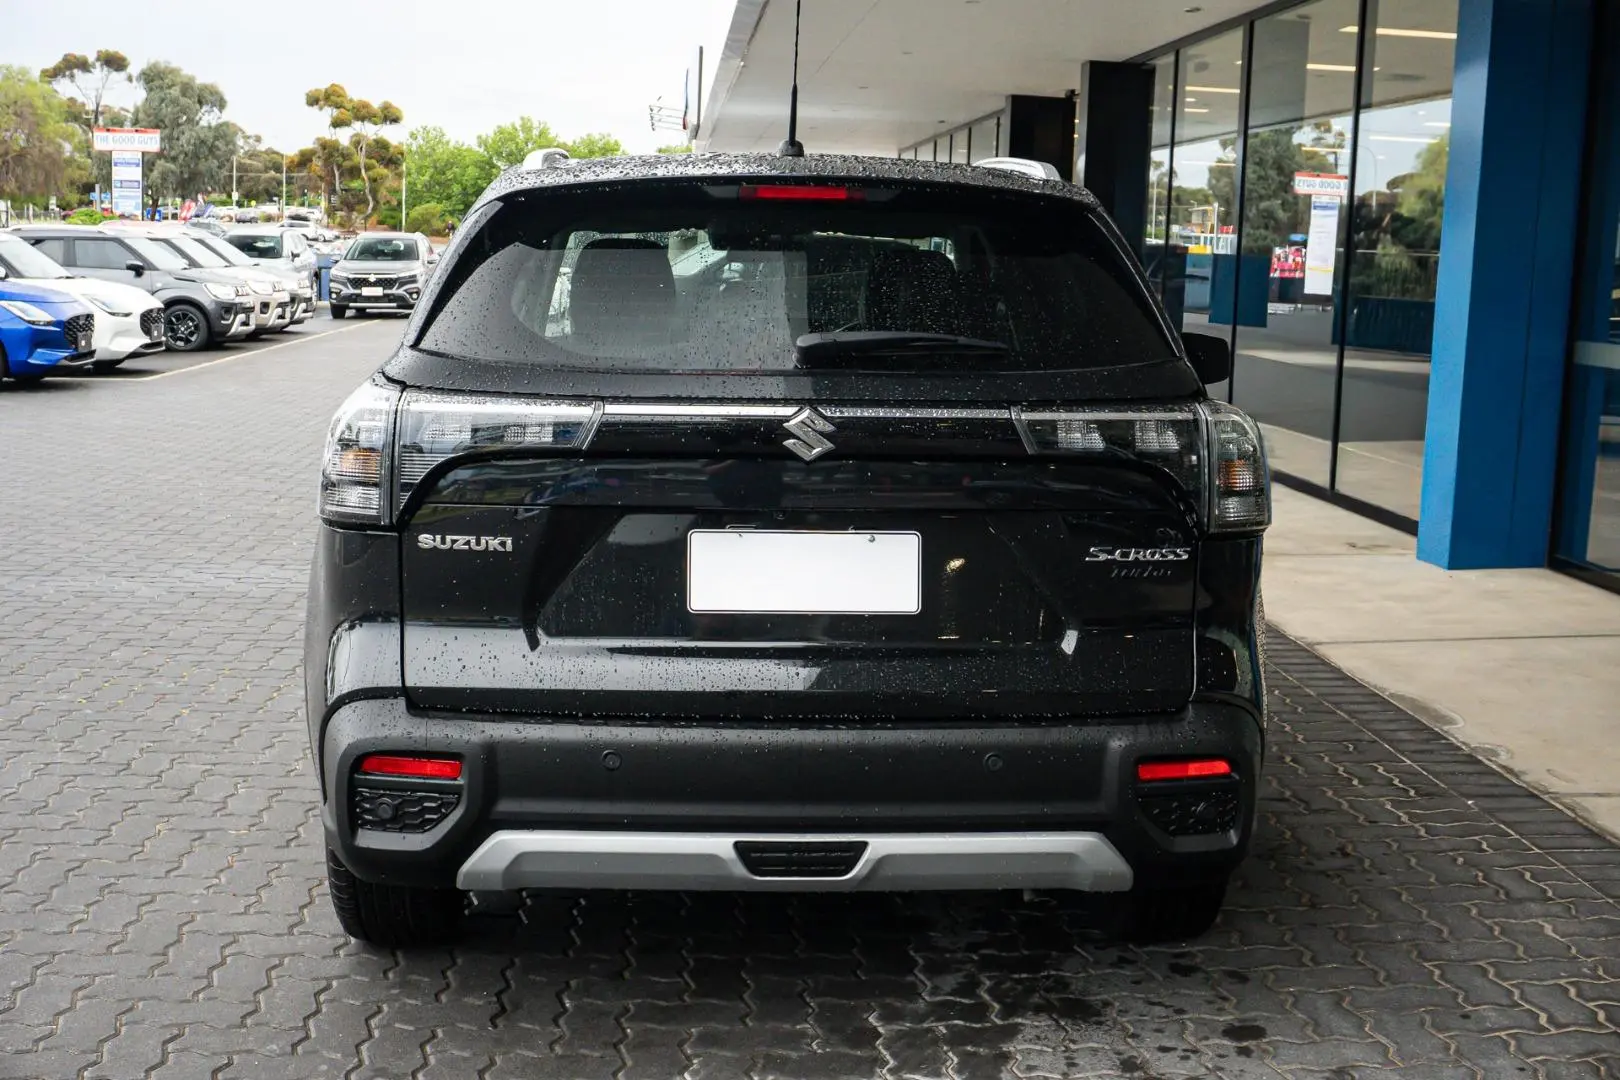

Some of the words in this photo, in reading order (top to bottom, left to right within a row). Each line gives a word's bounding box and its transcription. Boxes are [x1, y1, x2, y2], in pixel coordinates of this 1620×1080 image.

[95, 134, 110, 145] THE
[112, 135, 136, 145] GOOD
[137, 135, 158, 146] GUYS
[417, 533, 513, 552] SUZUKI
[1085, 546, 1191, 562] S-CROSS
